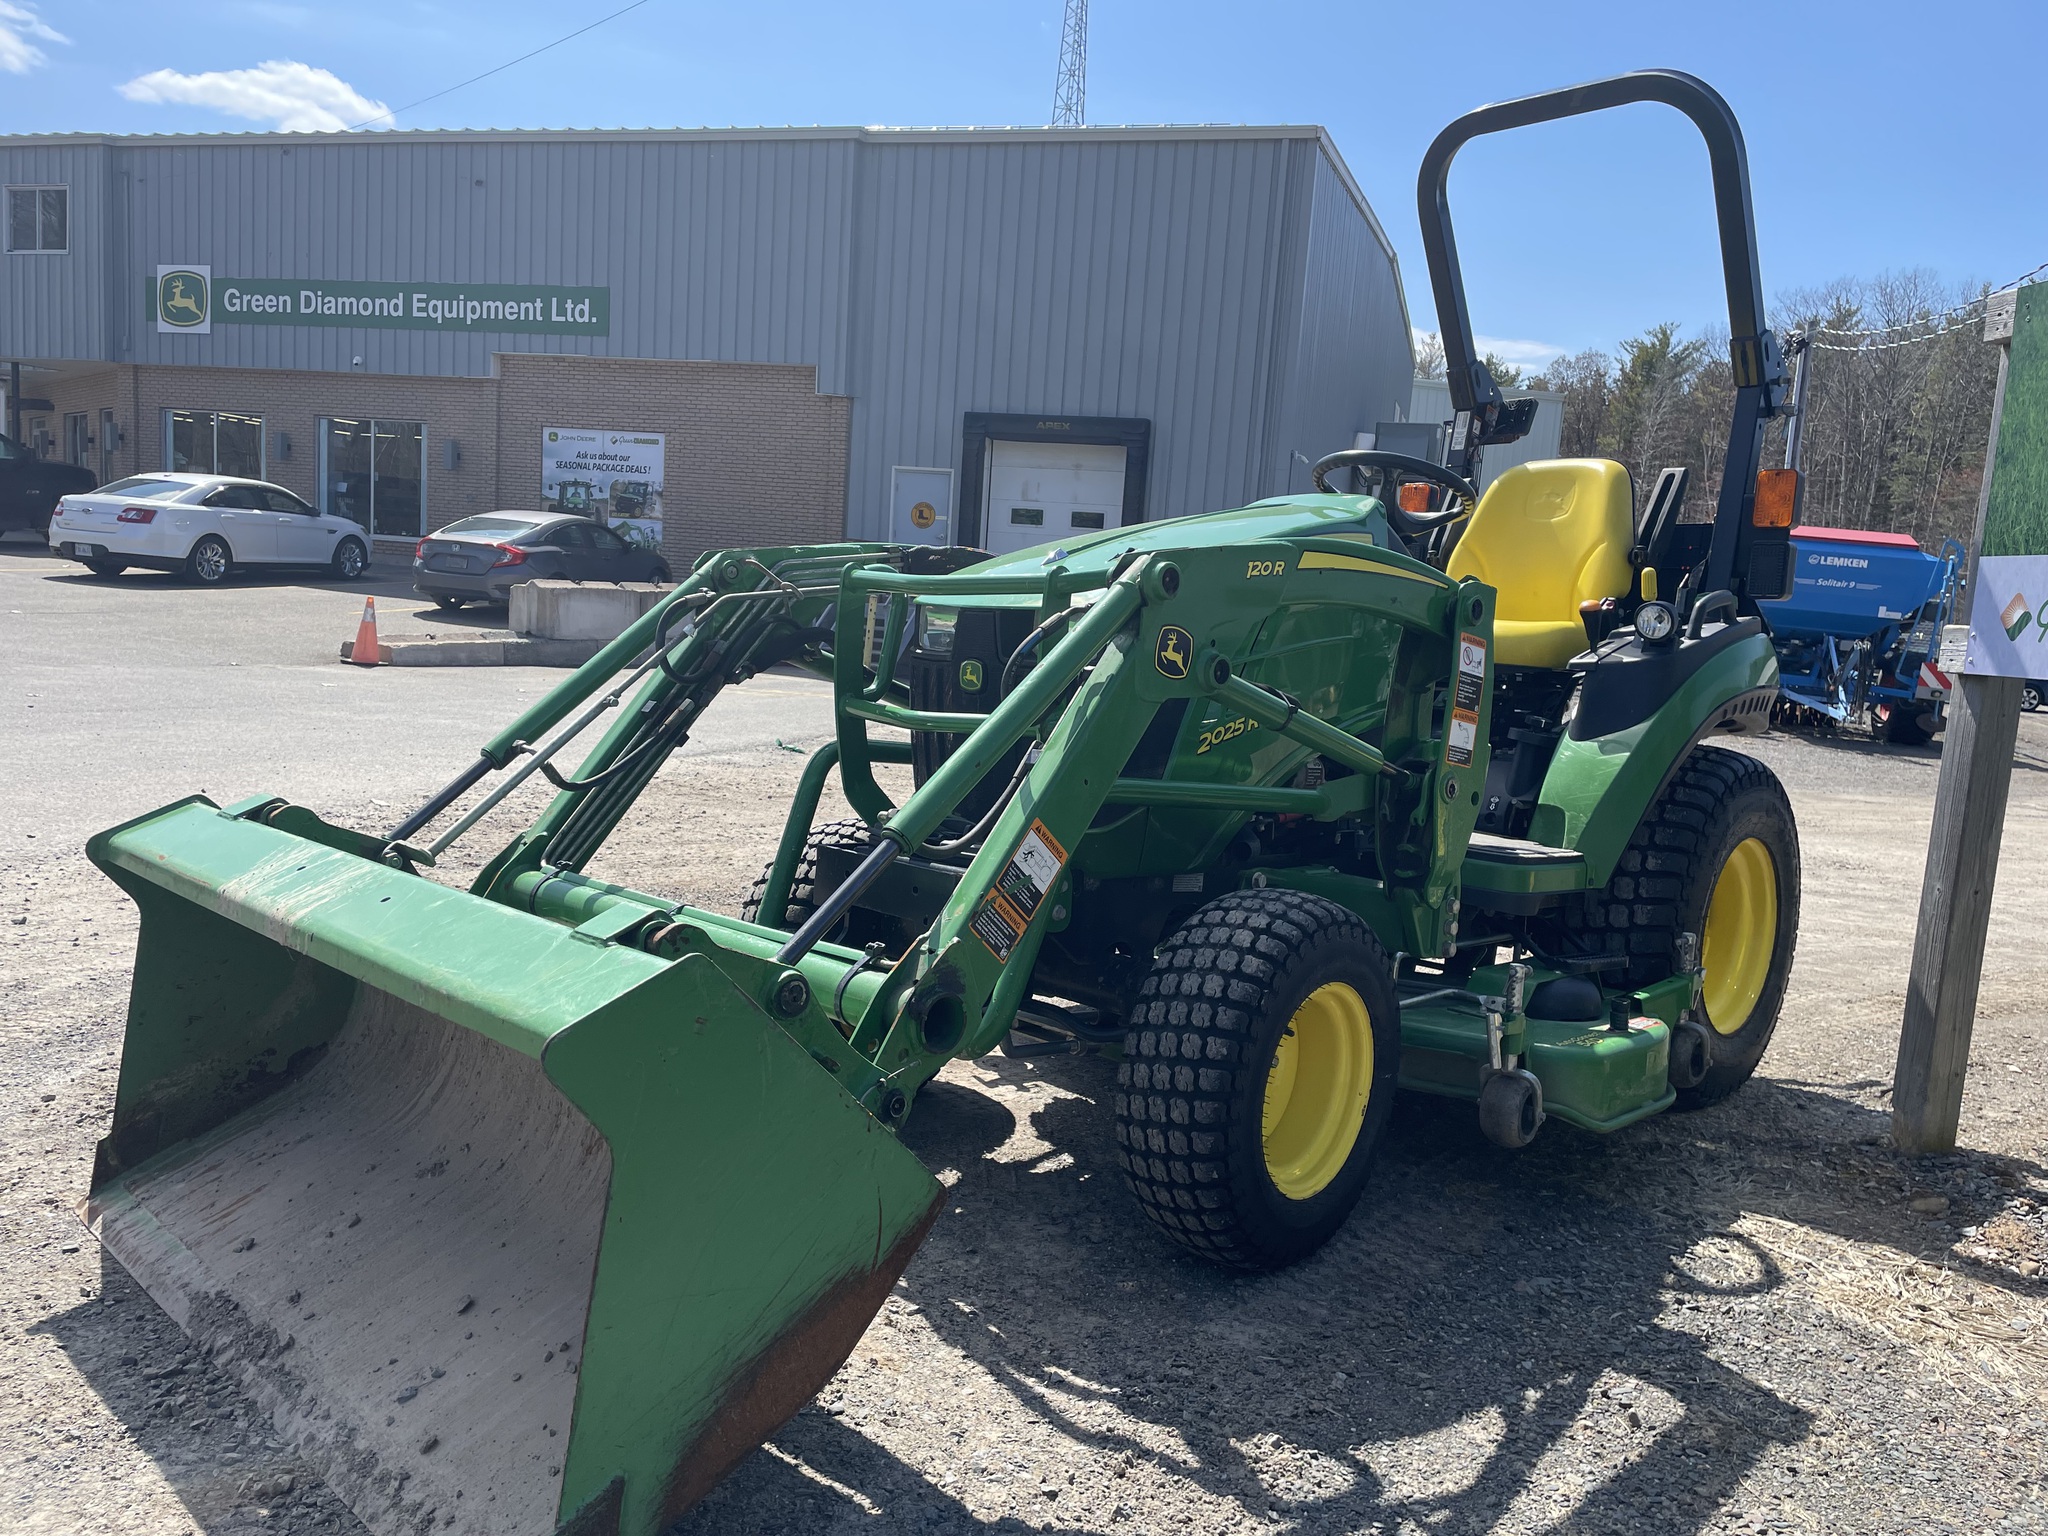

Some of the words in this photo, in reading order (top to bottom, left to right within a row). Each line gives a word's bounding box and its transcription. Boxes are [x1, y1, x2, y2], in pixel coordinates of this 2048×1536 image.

[223, 288, 292, 313] Green
[299, 290, 404, 317] Diamond
[412, 293, 544, 325] Equipment
[551, 297, 598, 323] Ltd.
[1036, 421, 1071, 431] APEX
[575, 450, 589, 460] Ask
[589, 453, 598, 461] us
[598, 451, 618, 462] about
[618, 455, 631, 463] our
[555, 460, 591, 470] SEASONAL
[592, 463, 625, 473] PACKAGE
[1820, 556, 1868, 568] LEMKEN
[1816, 578, 1848, 588] Solitair
[1848, 581, 1856, 589] 9
[1040, 829, 1064, 860] WARNING
[997, 901, 1022, 930] WARNING
